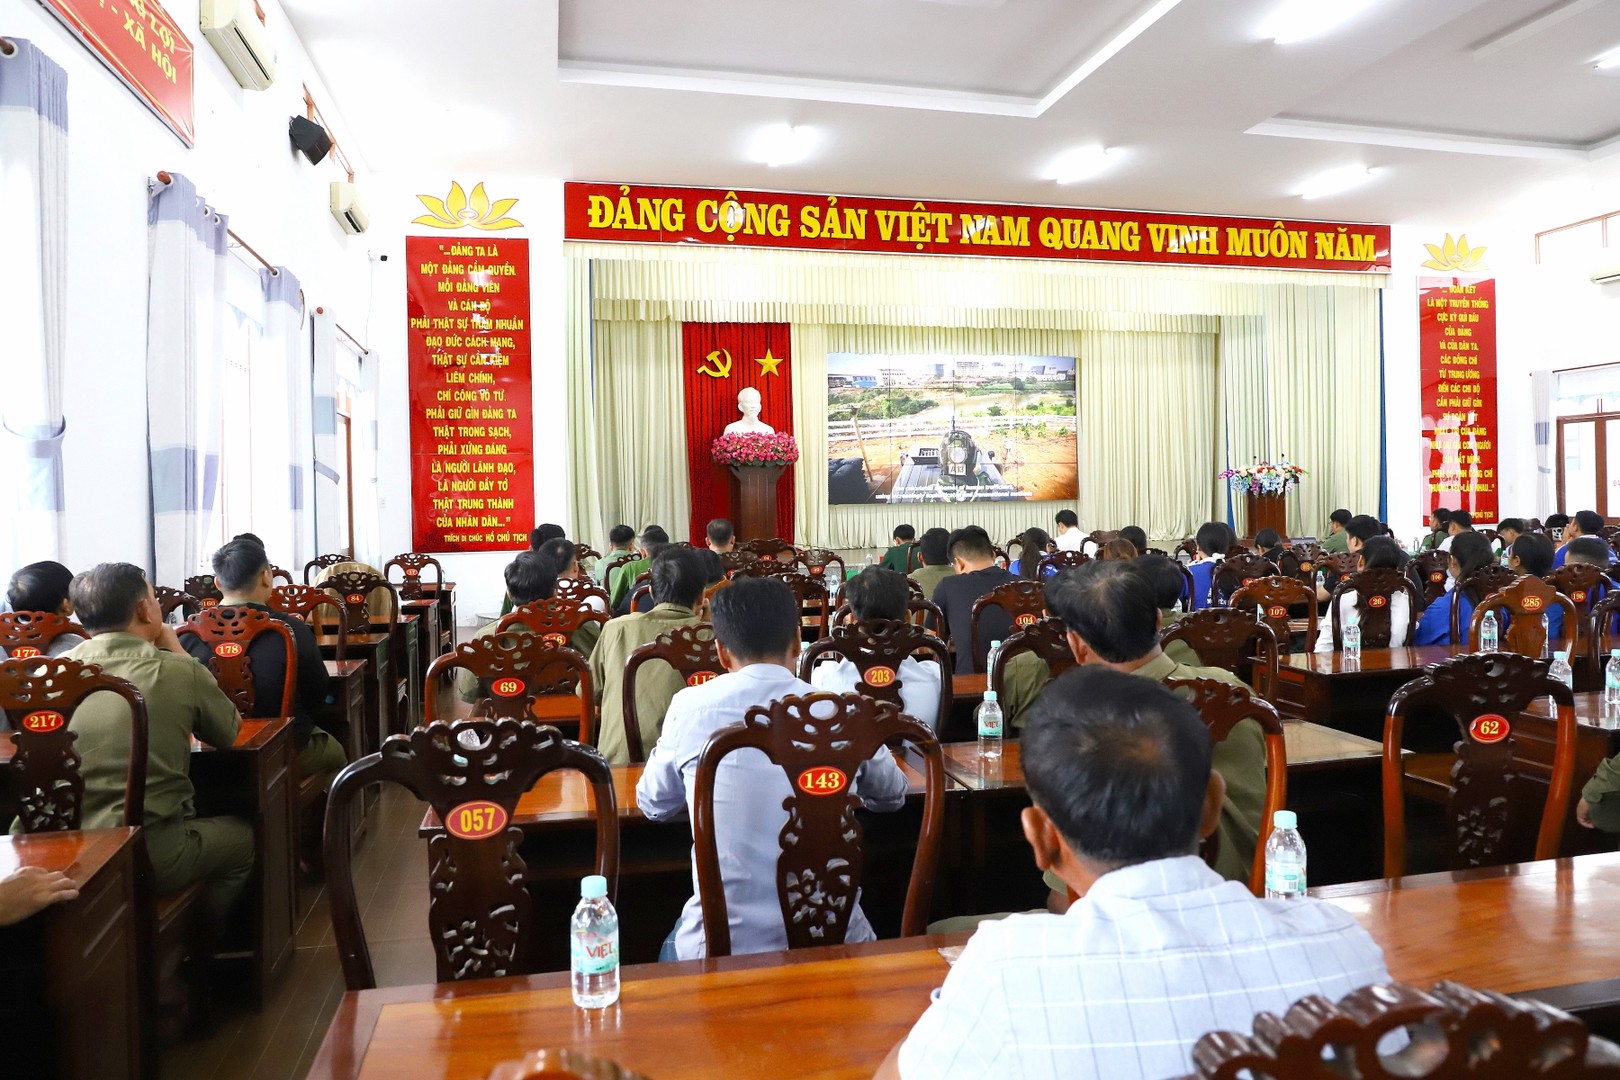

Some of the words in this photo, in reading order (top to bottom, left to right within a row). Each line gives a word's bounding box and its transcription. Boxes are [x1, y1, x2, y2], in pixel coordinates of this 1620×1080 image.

[150, 12, 174, 54] LỢI
[123, 10, 146, 51] XÃ
[152, 42, 176, 84] HỘI
[588, 185, 685, 231] ĐẢNG
[696, 191, 790, 242] CỘNG
[801, 196, 867, 239] SẢN
[875, 202, 952, 250] VIỆT
[960, 214, 1030, 246] NAM
[1038, 217, 1141, 252] QUANG
[1147, 223, 1218, 255] VINH
[1227, 221, 1307, 258] MUÔN
[1315, 226, 1375, 261] NĂM
[476, 246, 485, 256] TA
[488, 244, 498, 256] LÀ
[421, 262, 438, 276] MỘT
[442, 261, 464, 274] ĐẢNG
[456, 279, 478, 292] ĐẢNG
[448, 298, 458, 310] VÀ
[460, 299, 476, 311] CÁN
[480, 299, 490, 314] BỘ
[411, 315, 430, 328] PHẢI
[433, 317, 454, 331] THẬT
[457, 317, 468, 332] SỰ
[426, 337, 442, 348] ĐẠO
[446, 334, 462, 346] ĐỨC
[465, 335, 486, 347] CÁCH
[432, 353, 453, 367] THẬT
[456, 353, 467, 368] SỰ
[446, 371, 465, 383] LIÊM
[437, 389, 450, 401] CHÍ
[454, 389, 477, 401] CÔNG
[426, 405, 445, 419] PHẢI
[448, 406, 462, 419] GIỮ
[465, 406, 479, 419] GÌN
[482, 405, 504, 419] ĐẢNG
[507, 409, 517, 419] TA
[433, 425, 454, 440] THẬT
[458, 427, 485, 437] TRONG
[488, 427, 511, 439] SẠCH,
[438, 441, 457, 455] PHẢI
[461, 441, 482, 455] XỨNG
[485, 442, 507, 455] ĐÁNG
[432, 459, 442, 473] LÀ
[445, 459, 470, 473] NGƯỜI
[473, 462, 494, 473] LÃNH
[438, 477, 448, 491] LÀ
[452, 478, 476, 491] NGƯỜI
[433, 497, 453, 511] THẬT
[458, 499, 484, 510] TRUNG
[487, 497, 514, 510] THÀNH
[437, 513, 453, 527] CỦA
[456, 515, 478, 527] NHÂN
[469, 533, 483, 542] CHÚC
[497, 533, 510, 542] CHỦ
[513, 534, 527, 544] TỊCH
[1524, 598, 1540, 607] 285
[16, 650, 36, 658] 177
[218, 644, 239, 654] 178
[871, 670, 890, 682] 203
[500, 682, 517, 692] 69
[30, 715, 57, 728] 217
[1480, 721, 1499, 734] 62
[805, 772, 839, 789] 143
[460, 808, 495, 832] 057
